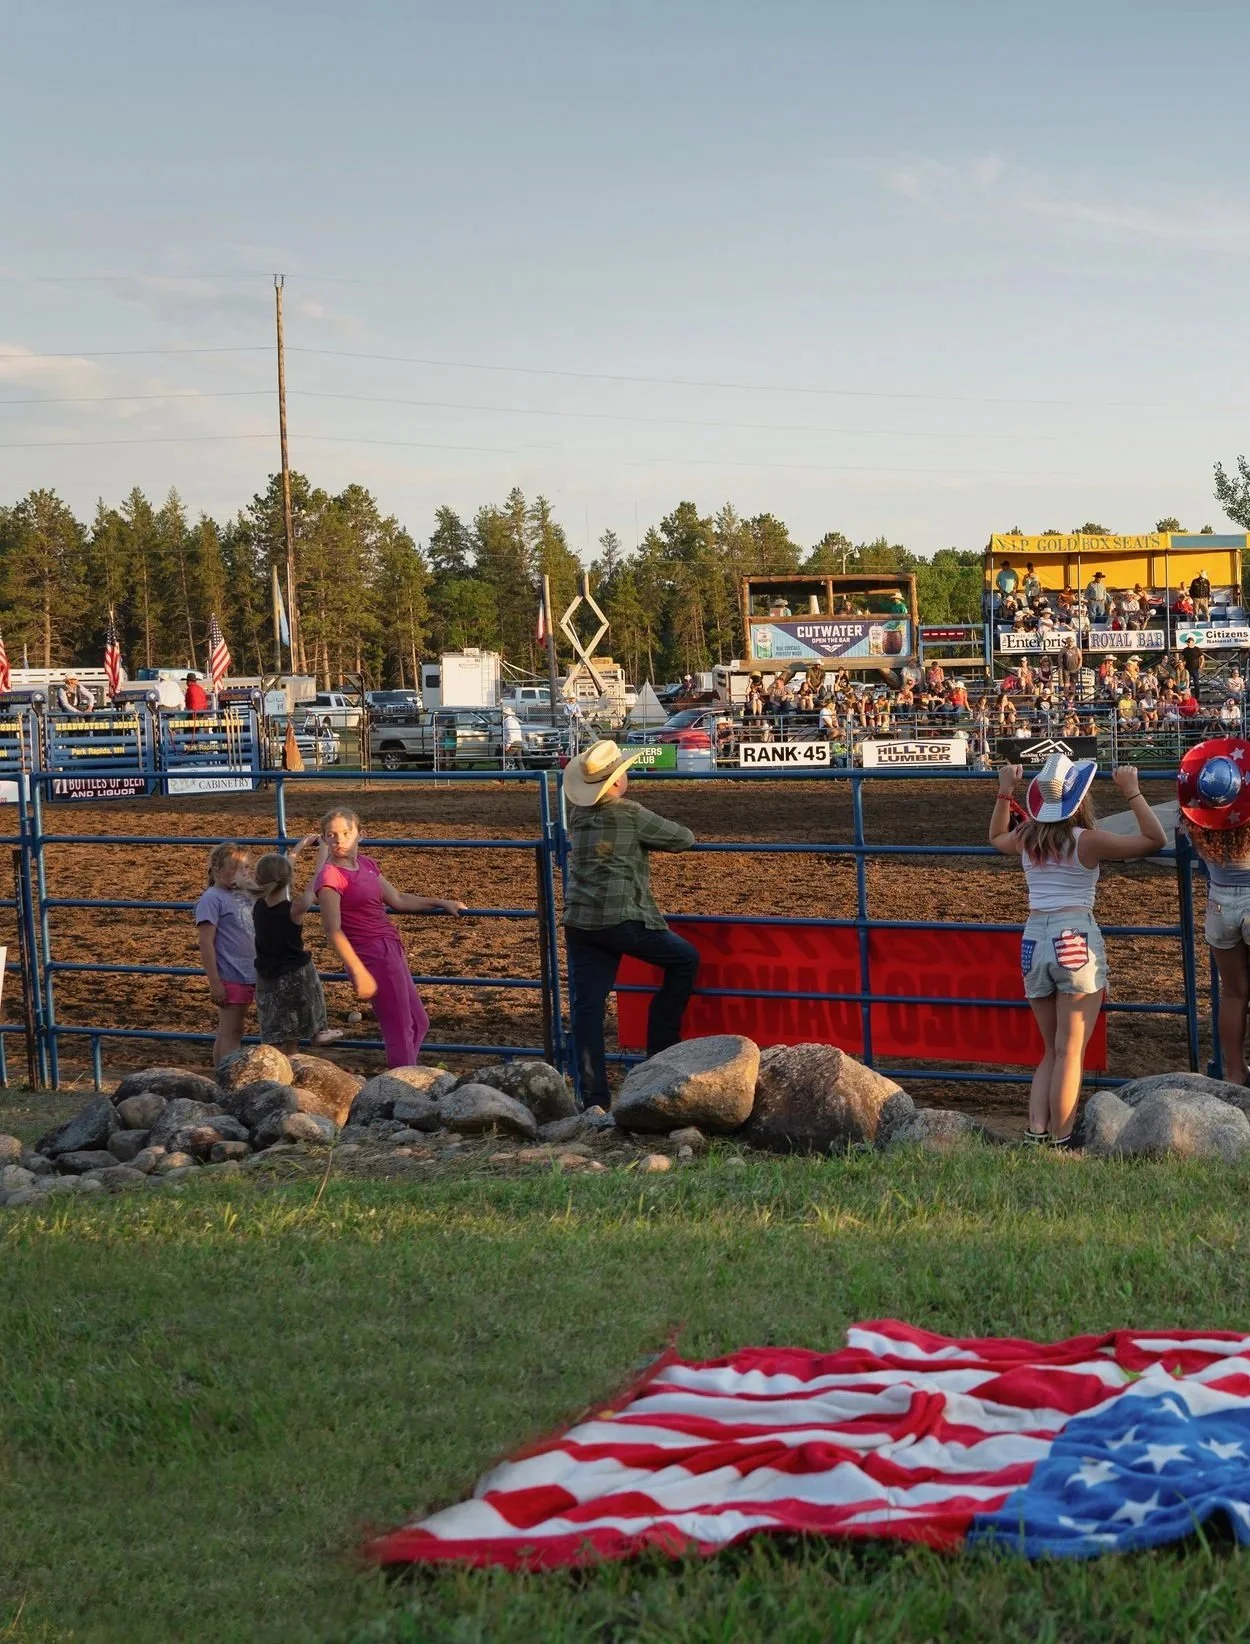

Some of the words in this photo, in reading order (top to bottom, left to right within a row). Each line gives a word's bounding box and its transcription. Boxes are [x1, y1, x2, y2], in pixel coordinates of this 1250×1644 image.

[1037, 538, 1078, 551] GOLD
[1083, 537, 1109, 551] BOX
[1112, 535, 1161, 550] SEATS
[797, 625, 863, 638] CUTWATER
[1206, 630, 1249, 639] Citizens
[1007, 633, 1067, 651] Enterpris
[1090, 634, 1132, 648] ROYAL
[1136, 633, 1164, 648] BAR
[56, 722, 110, 731] HEADWATERS
[169, 719, 218, 728] HEADWATERS
[72, 747, 87, 756] Park
[114, 746, 125, 754] MN
[184, 744, 197, 752] Park
[877, 743, 951, 754] HILLTOP
[877, 754, 951, 763] LUMBER
[54, 779, 68, 793] 71
[198, 778, 250, 790] CABINETRY
[71, 790, 94, 798] AND
[97, 788, 136, 797] LIQUOR
